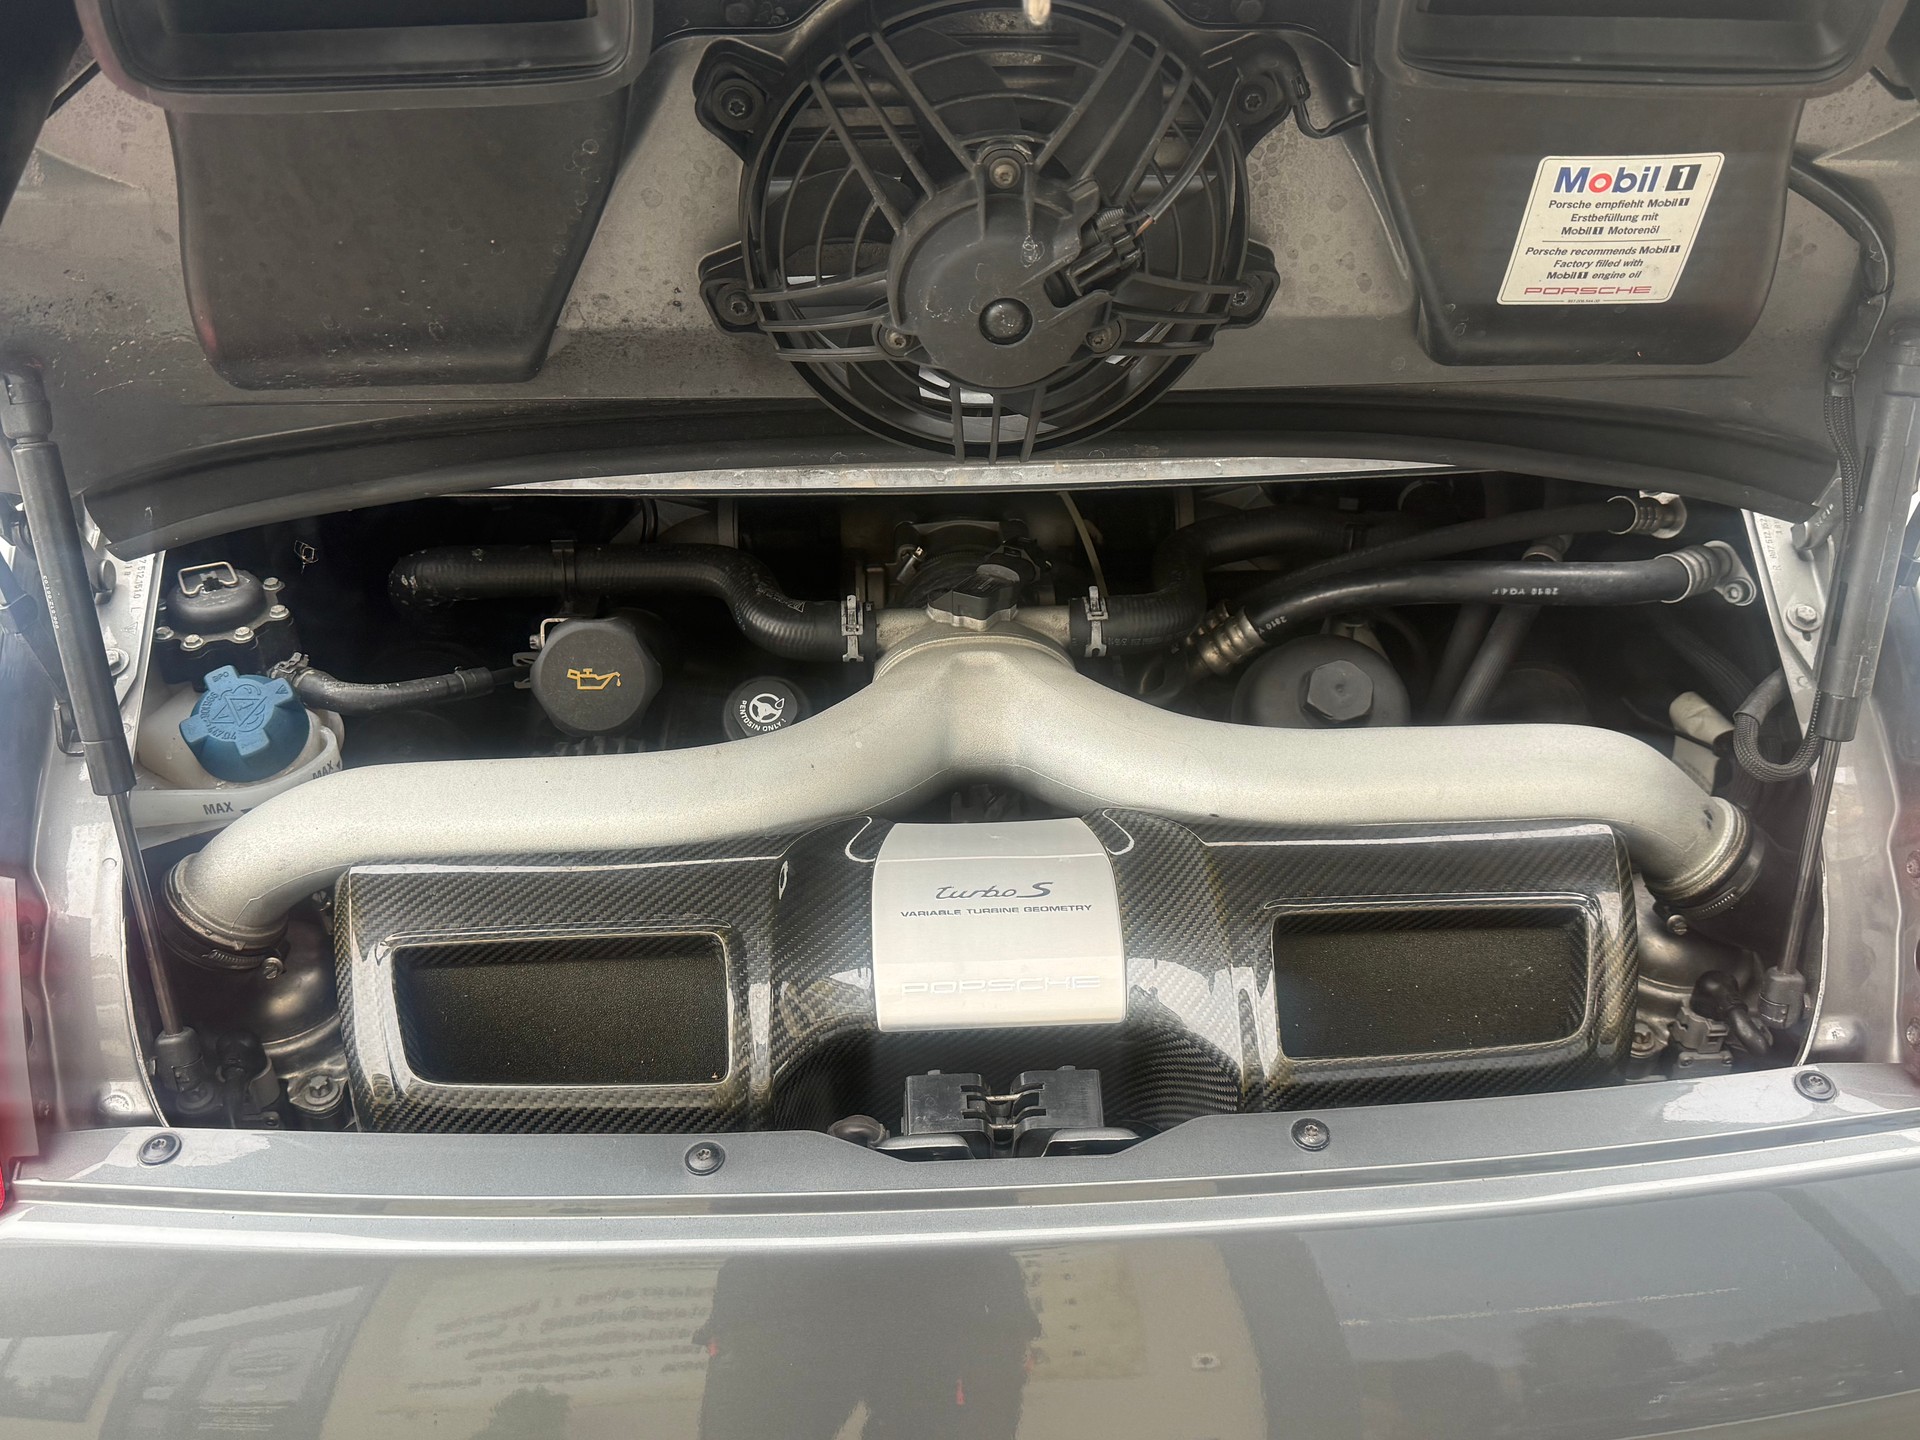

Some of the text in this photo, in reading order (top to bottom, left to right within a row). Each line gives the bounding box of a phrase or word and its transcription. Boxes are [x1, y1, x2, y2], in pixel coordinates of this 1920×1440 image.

[1553, 166, 1662, 193] Mobil
[1548, 200, 1592, 209] Porsche
[1595, 199, 1644, 210] empfiehlt
[1570, 213, 1659, 223] Erstbefüllung mit
[1607, 225, 1660, 235] Motorenöl
[1525, 247, 1568, 256] Porsche
[1570, 246, 1637, 256] recommends
[1553, 259, 1644, 269] Factory filled with
[1592, 271, 1626, 280] engine
[1628, 270, 1642, 279] oil
[1523, 286, 1652, 295] PORSCHE
[739, 699, 761, 731] PENTOSIN
[312, 760, 334, 779] MAX
[202, 801, 234, 815] MAX
[935, 881, 1054, 900] Turbo S
[900, 904, 1093, 918] VARIABLE TURBINE GEOMETRY
[901, 974, 1101, 994] PORSCHE
